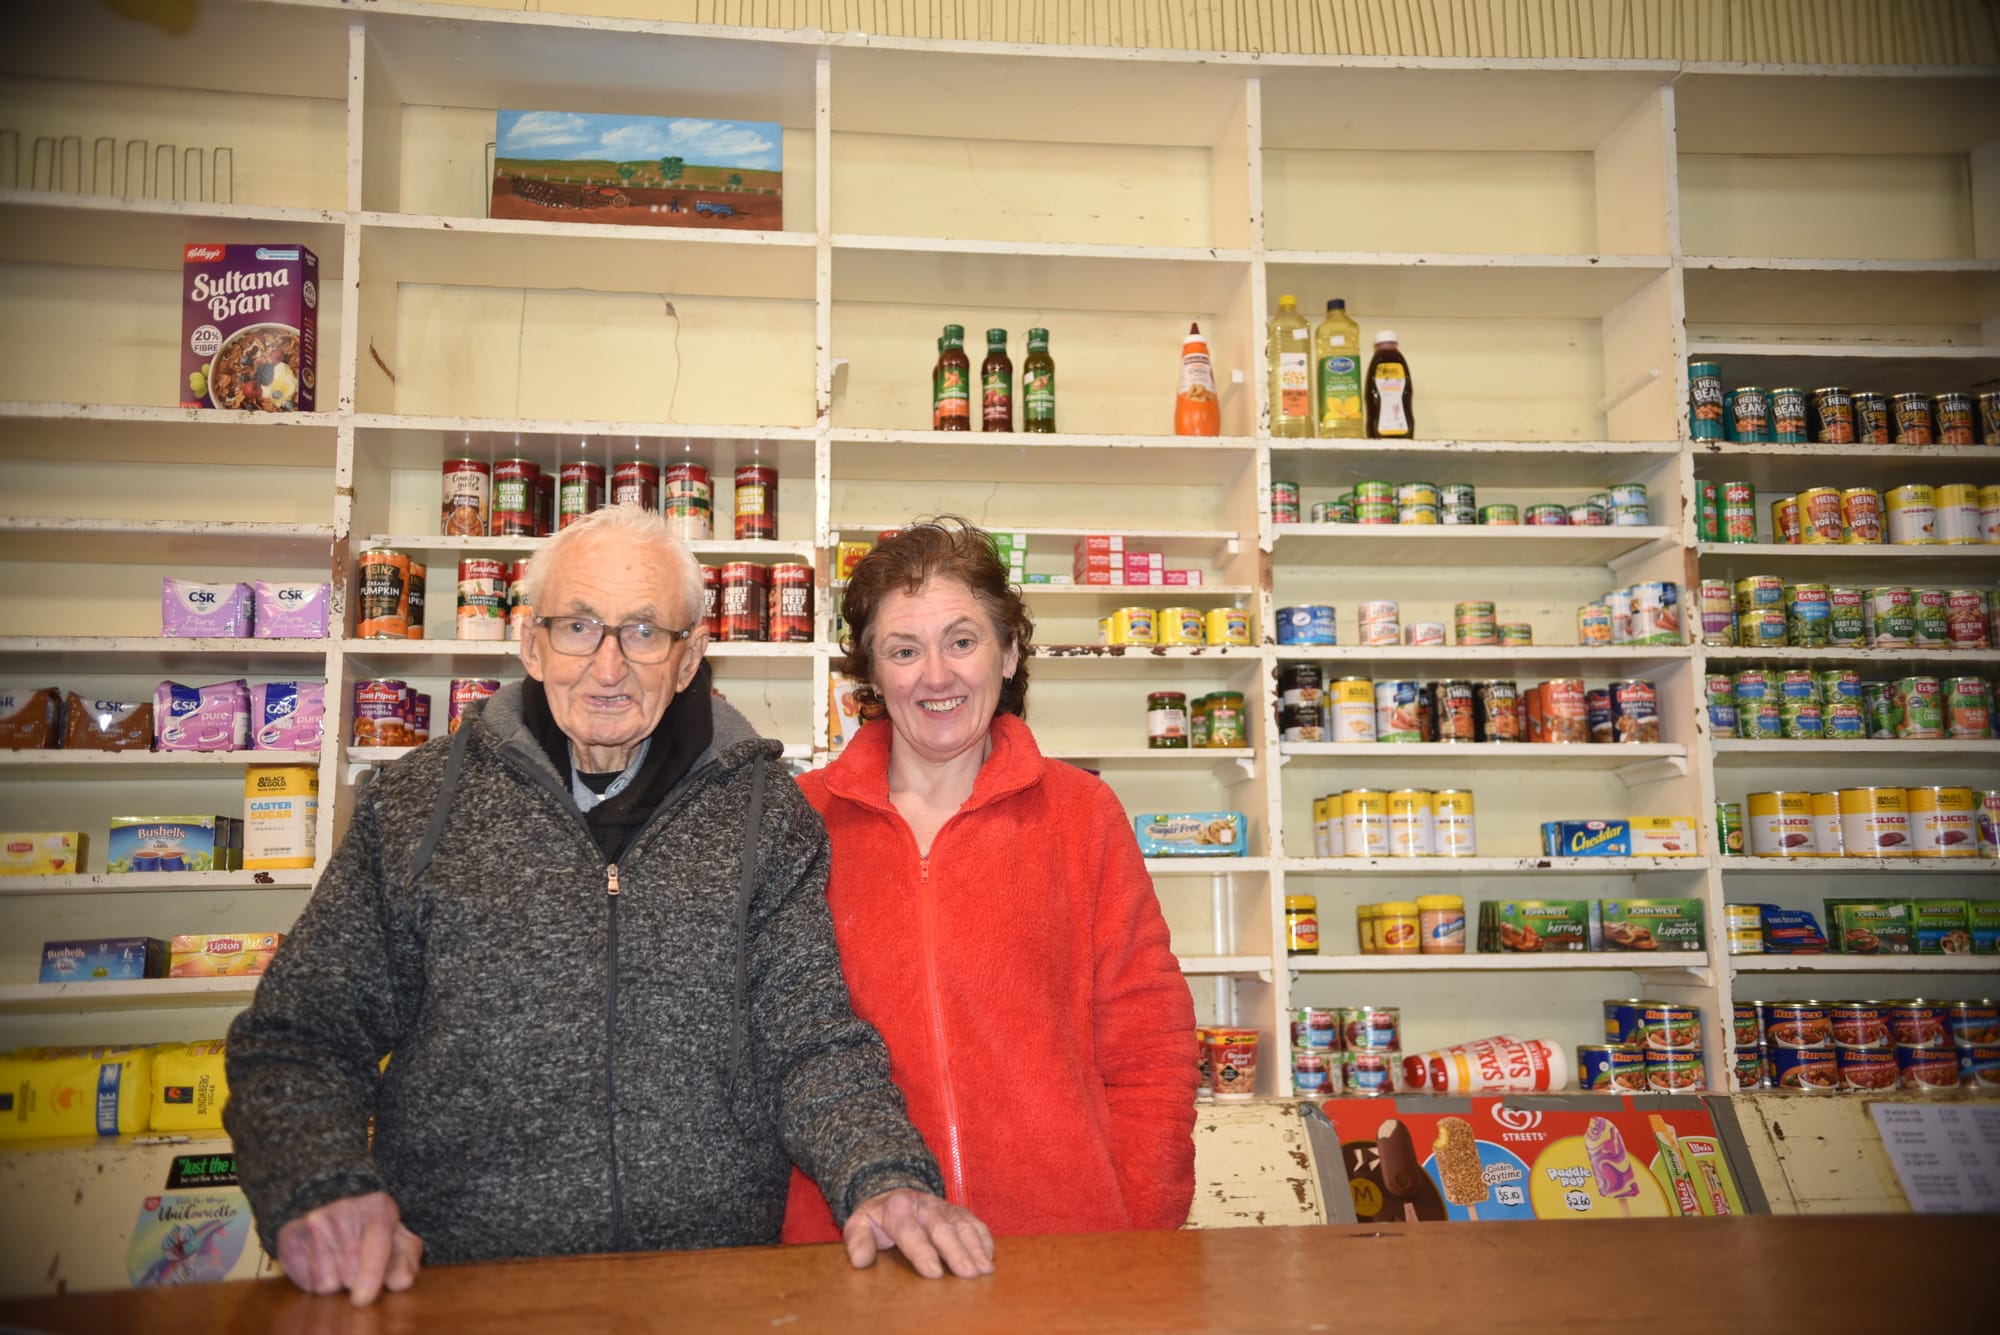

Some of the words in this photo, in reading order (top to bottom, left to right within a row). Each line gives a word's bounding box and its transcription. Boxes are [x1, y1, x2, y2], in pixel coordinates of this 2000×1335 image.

[188, 247, 221, 260] Kellogg's
[191, 268, 289, 302] Sultana
[208, 293, 272, 321] Bran
[195, 331, 220, 340] 20%
[194, 344, 219, 352] FIBRE
[1694, 389, 1722, 401] BEAN
[1738, 395, 1762, 404] HEINZ
[1778, 395, 1802, 404] HEINZ
[1735, 405, 1767, 415] BEANZ
[1774, 405, 1805, 416] BEANZ
[1905, 402, 1929, 411] HEINZ
[1816, 496, 1839, 504] HEINZ
[1852, 497, 1876, 505] HEINZ
[366, 564, 394, 576] HEINZ
[278, 590, 303, 600] CSR
[360, 587, 400, 597] PUMPKIN
[1799, 591, 1826, 601] Edgell
[189, 592, 215, 604] CSR
[725, 594, 748, 603] BEEF
[783, 595, 806, 605] BEEF
[1834, 595, 1860, 603] Edgell
[1950, 598, 1979, 607] Edgell
[359, 692, 374, 701] Tom
[374, 692, 397, 701] Piper
[456, 692, 471, 700] Tom
[95, 700, 124, 712] CSR
[172, 700, 199, 711] CSR
[266, 703, 292, 714] CSR
[201, 712, 229, 722] pure
[297, 714, 322, 724] pure
[250, 802, 292, 810] CASTER
[250, 810, 292, 820] SUGAR
[1933, 815, 1968, 823] SLICED
[138, 826, 186, 840] Bushells
[1150, 825, 1178, 836] Sugar
[1180, 824, 1201, 833] Free
[1571, 825, 1623, 852] Cheddar
[1525, 908, 1543, 916] JOHN
[1544, 907, 1567, 915] WEST
[1547, 920, 1583, 935] herring
[1657, 923, 1698, 936] kippers
[209, 941, 240, 952] Lipton
[47, 948, 86, 959] Bushells
[1645, 1010, 1692, 1019] Harvest
[1774, 1010, 1822, 1018] Harvest
[1647, 1052, 1694, 1061] Harvest
[1844, 1051, 1893, 1061] Harvest
[198, 1074, 210, 1115] BUNDABERG
[208, 1084, 216, 1106] SUGAR
[99, 1092, 115, 1130] WHITE
[1502, 1132, 1544, 1142] STREETS
[1687, 1142, 1712, 1153] Weis
[209, 1157, 228, 1174] the
[1487, 1165, 1512, 1173] Golden
[1482, 1171, 1521, 1184] Gaytime
[1353, 1186, 1374, 1203] M
[1498, 1190, 1520, 1201] $5.10
[1679, 1182, 1693, 1210] Weis
